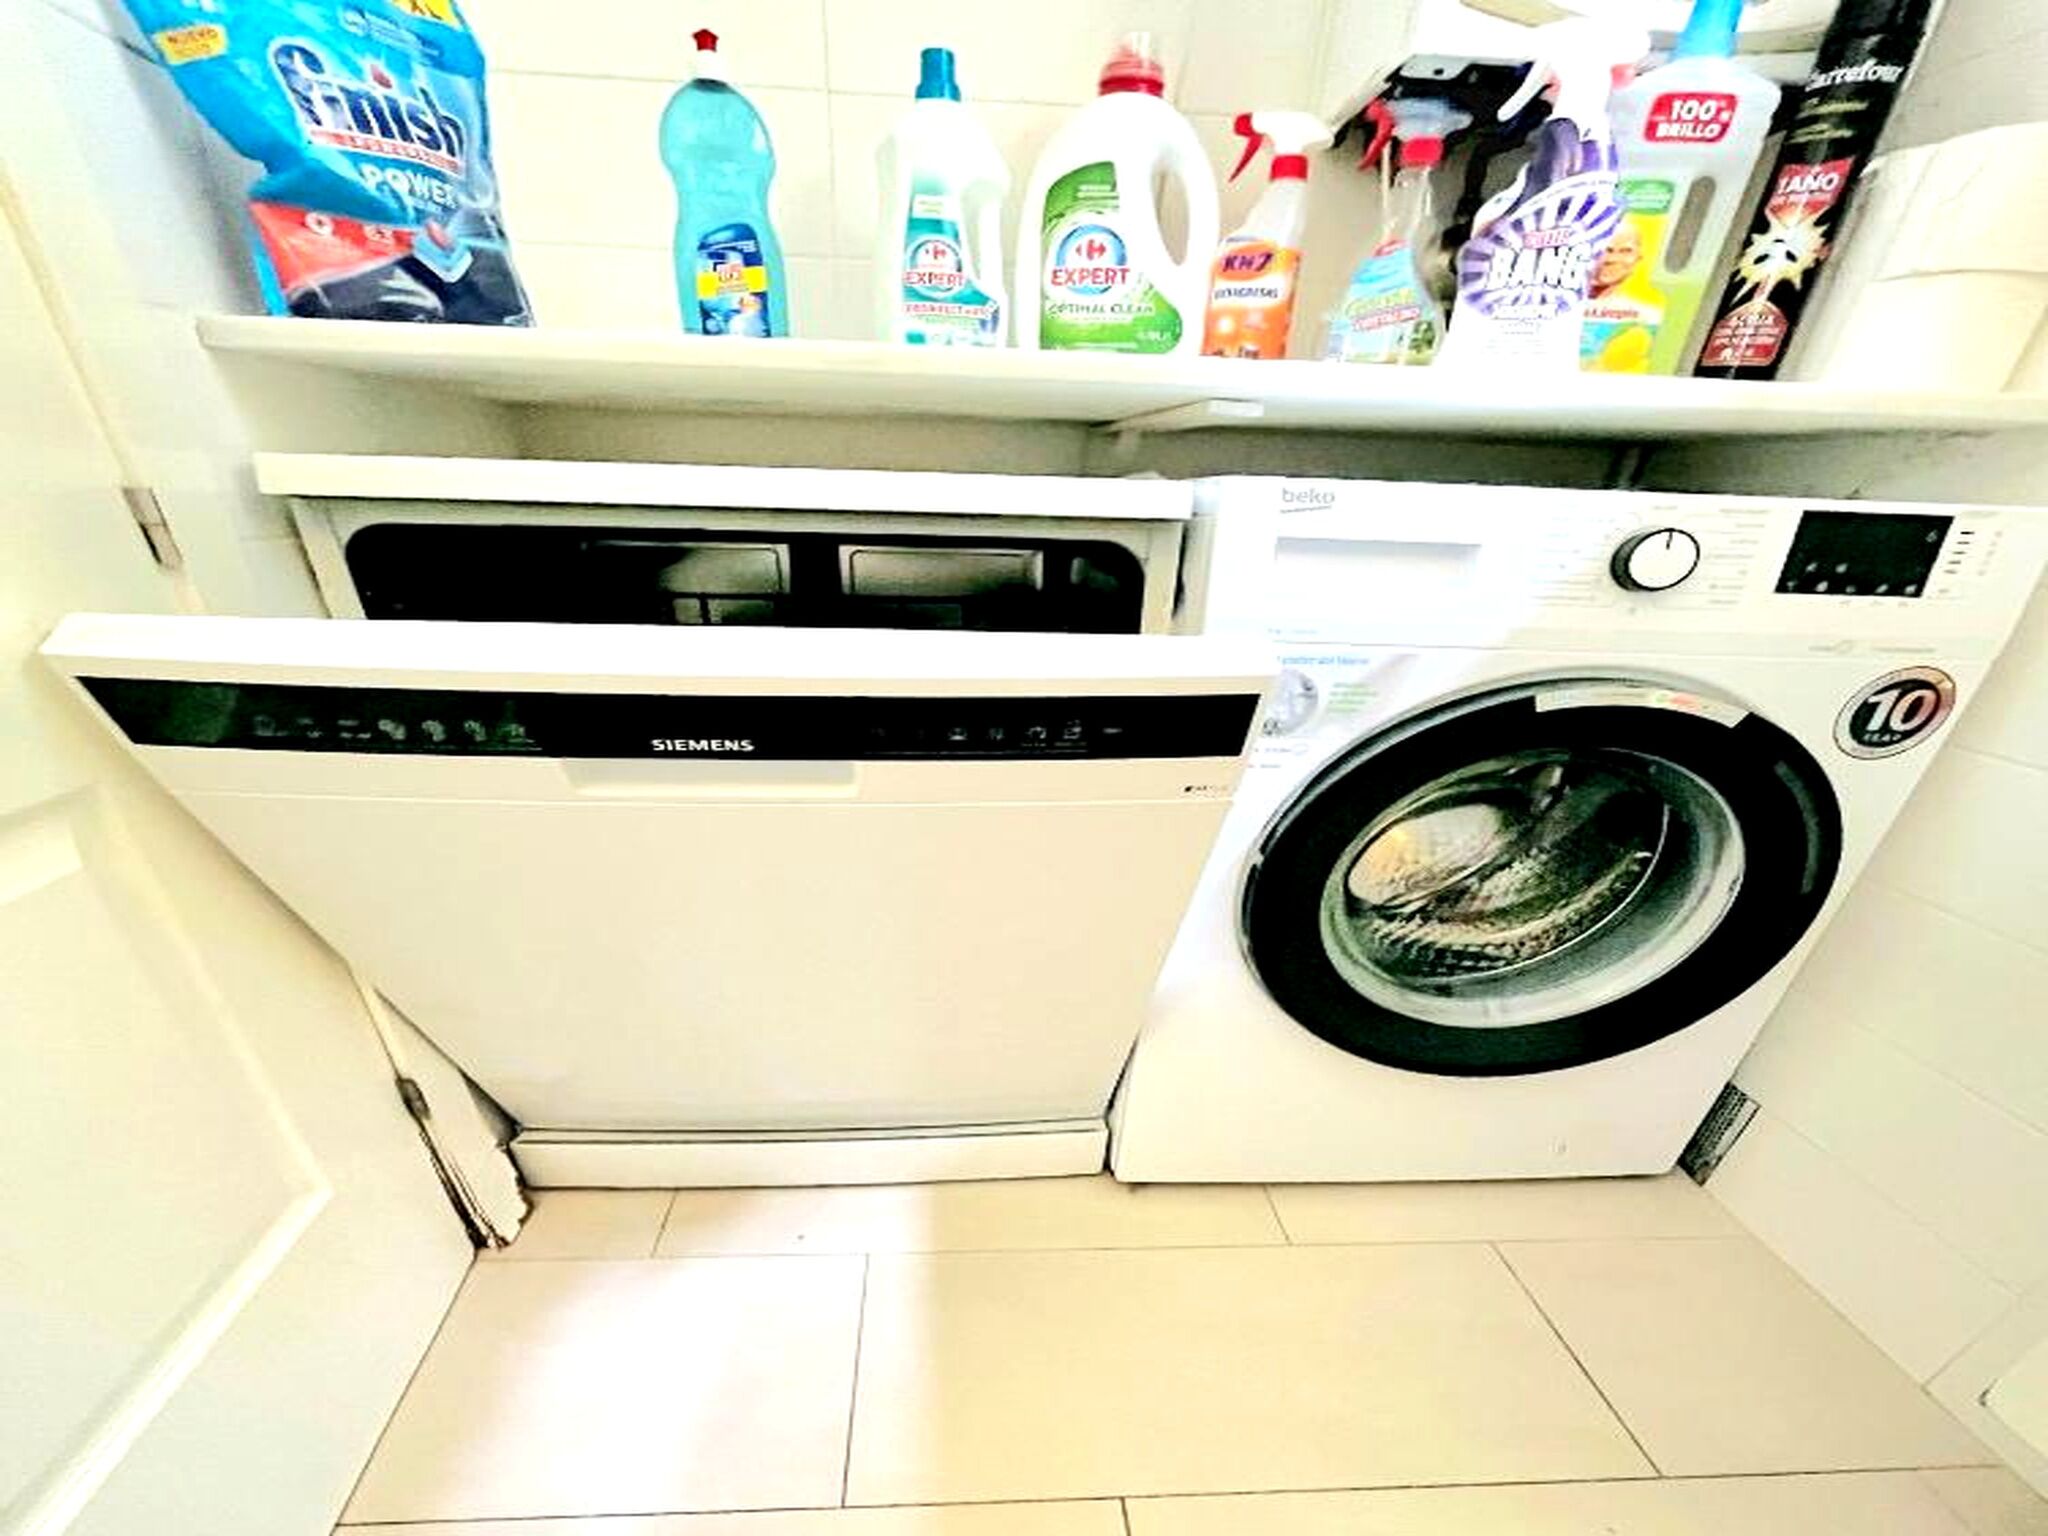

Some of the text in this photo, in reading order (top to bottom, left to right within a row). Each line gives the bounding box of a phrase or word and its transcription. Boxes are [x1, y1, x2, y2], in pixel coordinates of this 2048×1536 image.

[1655, 122, 1723, 138] BRILLO
[904, 271, 966, 287] EXPERT
[1050, 267, 1131, 287] EXPERT
[1281, 487, 1337, 505] beko
[1865, 688, 1938, 732] 10
[650, 738, 756, 752] SIEMENS
